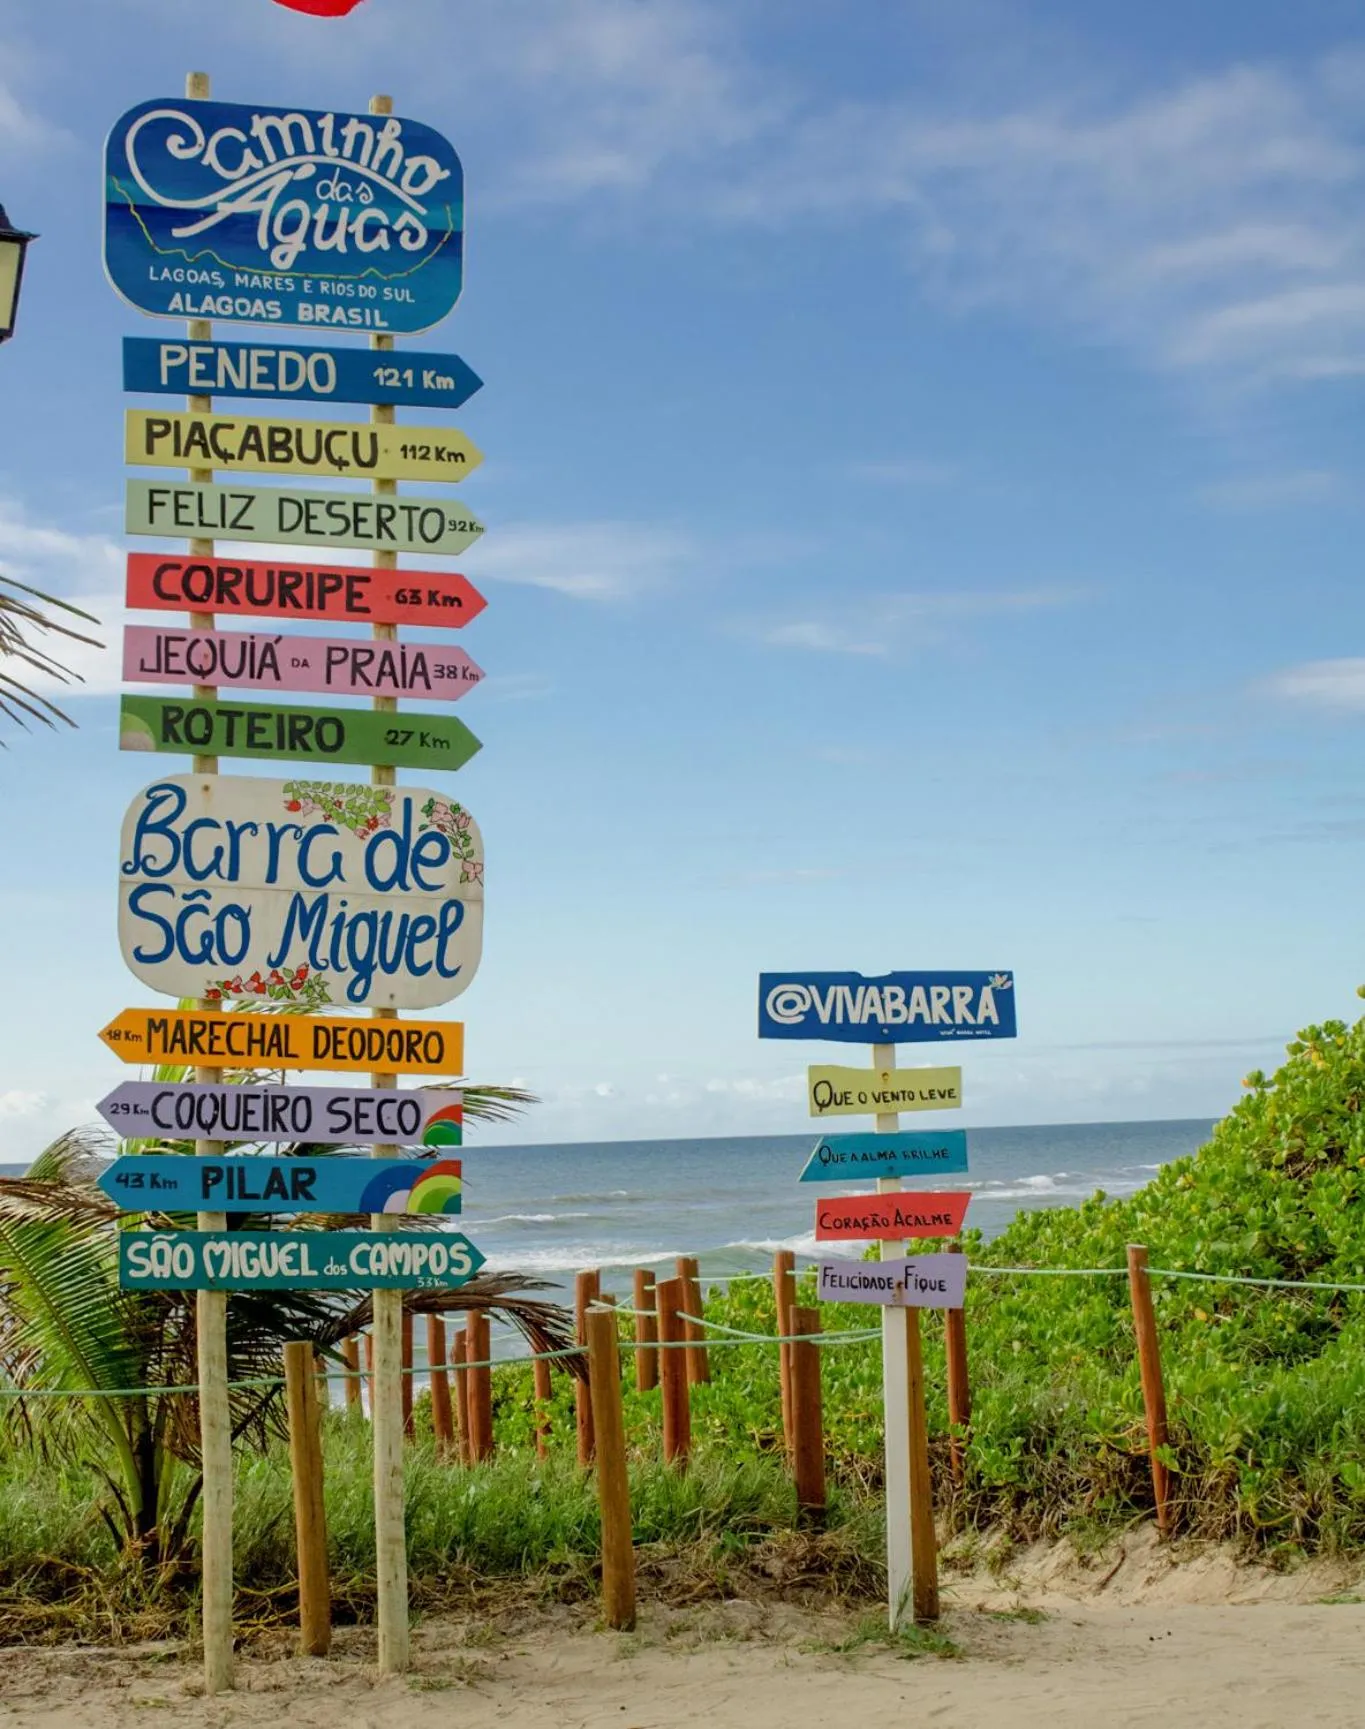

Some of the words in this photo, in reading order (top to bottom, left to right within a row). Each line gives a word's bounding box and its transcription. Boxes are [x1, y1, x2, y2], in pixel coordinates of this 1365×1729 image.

[125, 109, 450, 215] Caminho
[316, 167, 374, 202] das
[172, 163, 428, 270] Águas
[149, 266, 225, 288] LAGOAS,
[235, 270, 296, 292] MARES
[303, 279, 314, 294] E
[320, 280, 355, 297] RIOS
[358, 284, 377, 299] DO
[383, 287, 416, 303] SUL
[168, 292, 282, 319] ALAGOAS
[298, 303, 389, 327] BRASIL
[160, 344, 337, 394] PENEDO
[372, 366, 414, 388] 121
[423, 370, 455, 391] Km
[145, 418, 379, 471] PIAÇABUÇU
[400, 444, 431, 461] 112
[434, 446, 466, 463] Km
[148, 488, 255, 531] FELIZ
[278, 497, 445, 544] DESERTO
[152, 563, 372, 614] CORURIPE
[395, 588, 422, 605] 63
[428, 589, 463, 608] Km
[139, 634, 283, 680] JEQUIÁ
[291, 657, 310, 669] DA
[326, 645, 432, 690] PRAIA
[433, 664, 458, 679] 38
[161, 705, 345, 753] ROTEIRO
[384, 729, 412, 746] 27
[420, 731, 451, 750] Km
[121, 783, 347, 888] Barra
[365, 797, 451, 892] de
[128, 882, 252, 966] São
[267, 892, 465, 1003] Miguel
[766, 984, 1000, 1025] @VIVABARRA
[147, 1017, 298, 1058] MARECHAL
[313, 1025, 444, 1064] DEODORO
[110, 1103, 130, 1115] 29
[150, 1089, 313, 1136] COQUEIRO
[326, 1097, 421, 1136] SECO
[813, 1080, 854, 1112] QUE
[858, 1091, 867, 1104] O
[871, 1088, 915, 1104] VENTO
[919, 1087, 956, 1100] LEVE
[115, 1173, 145, 1189] 43
[150, 1173, 178, 1190] Km
[201, 1165, 317, 1201] PILAR
[127, 1233, 195, 1278] SÃO
[203, 1241, 318, 1278] MIGUEL
[323, 1255, 348, 1276] dos
[349, 1241, 473, 1276] CAMPOS
